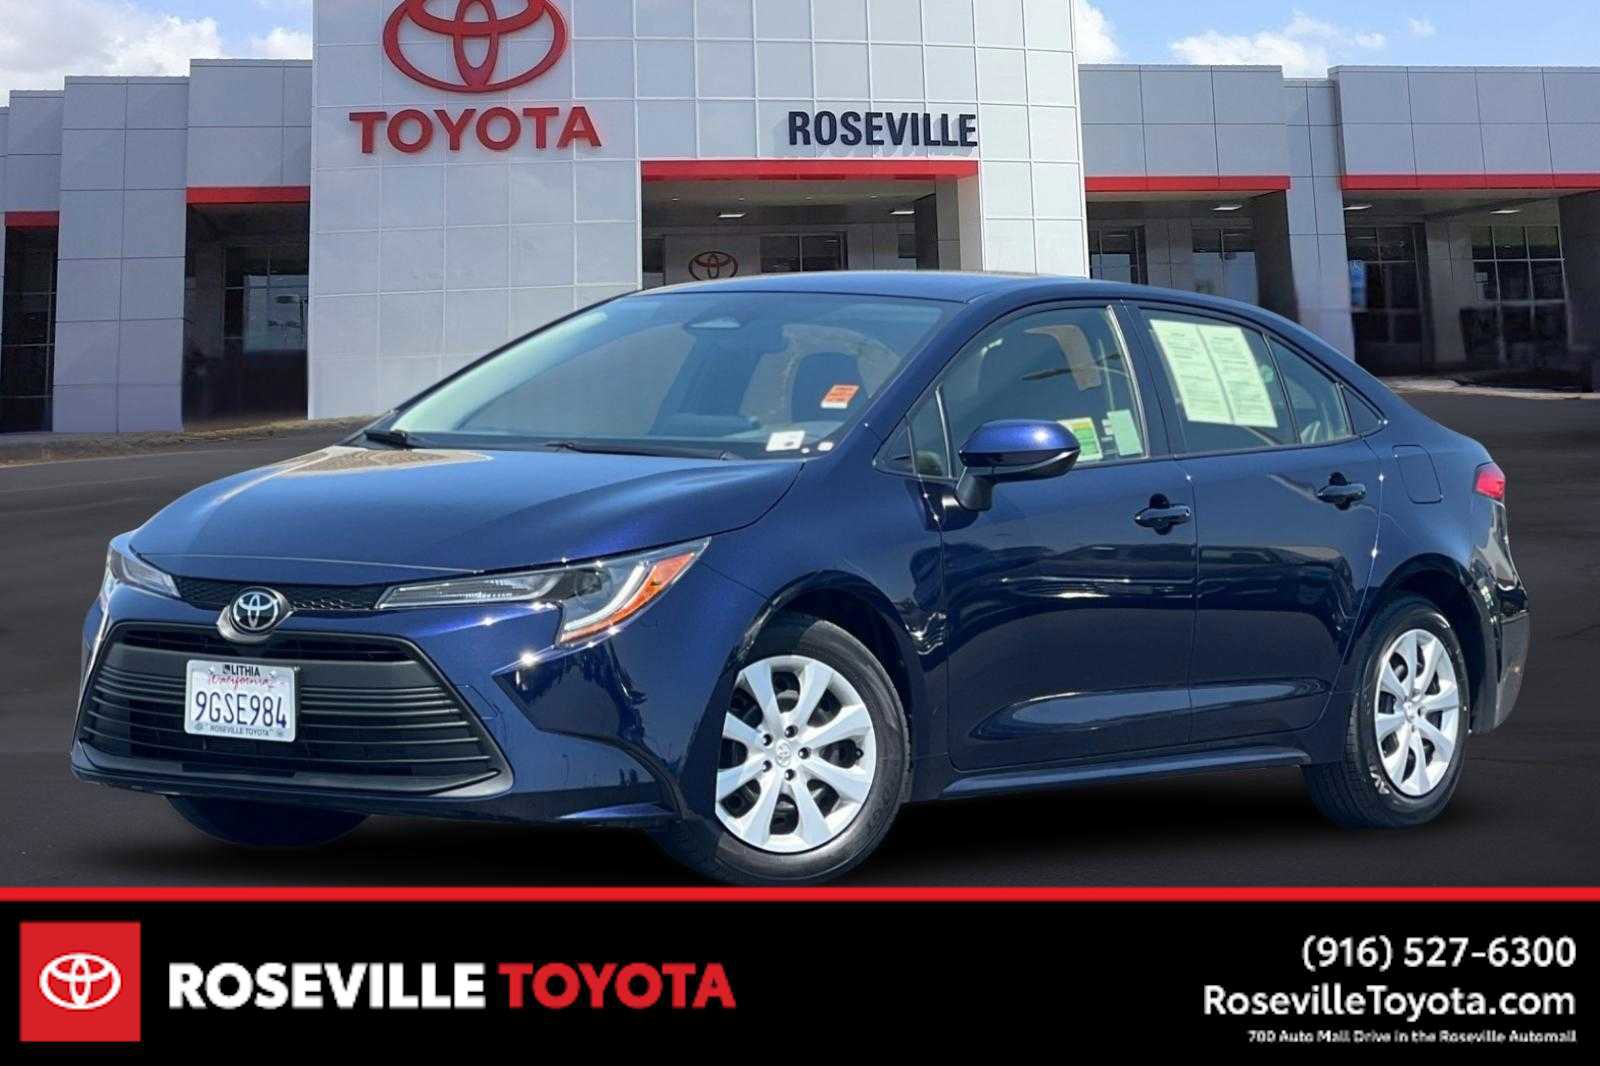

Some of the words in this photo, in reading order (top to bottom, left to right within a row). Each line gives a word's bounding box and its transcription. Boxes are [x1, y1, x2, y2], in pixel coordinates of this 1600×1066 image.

[349, 106, 602, 154] TOYOTA
[788, 110, 978, 147] ROSEVILLE
[231, 664, 260, 677] LITHIA
[195, 690, 287, 728] 9GSE984
[210, 725, 243, 735] ROSEVILLE
[246, 728, 270, 737] TOYOTA
